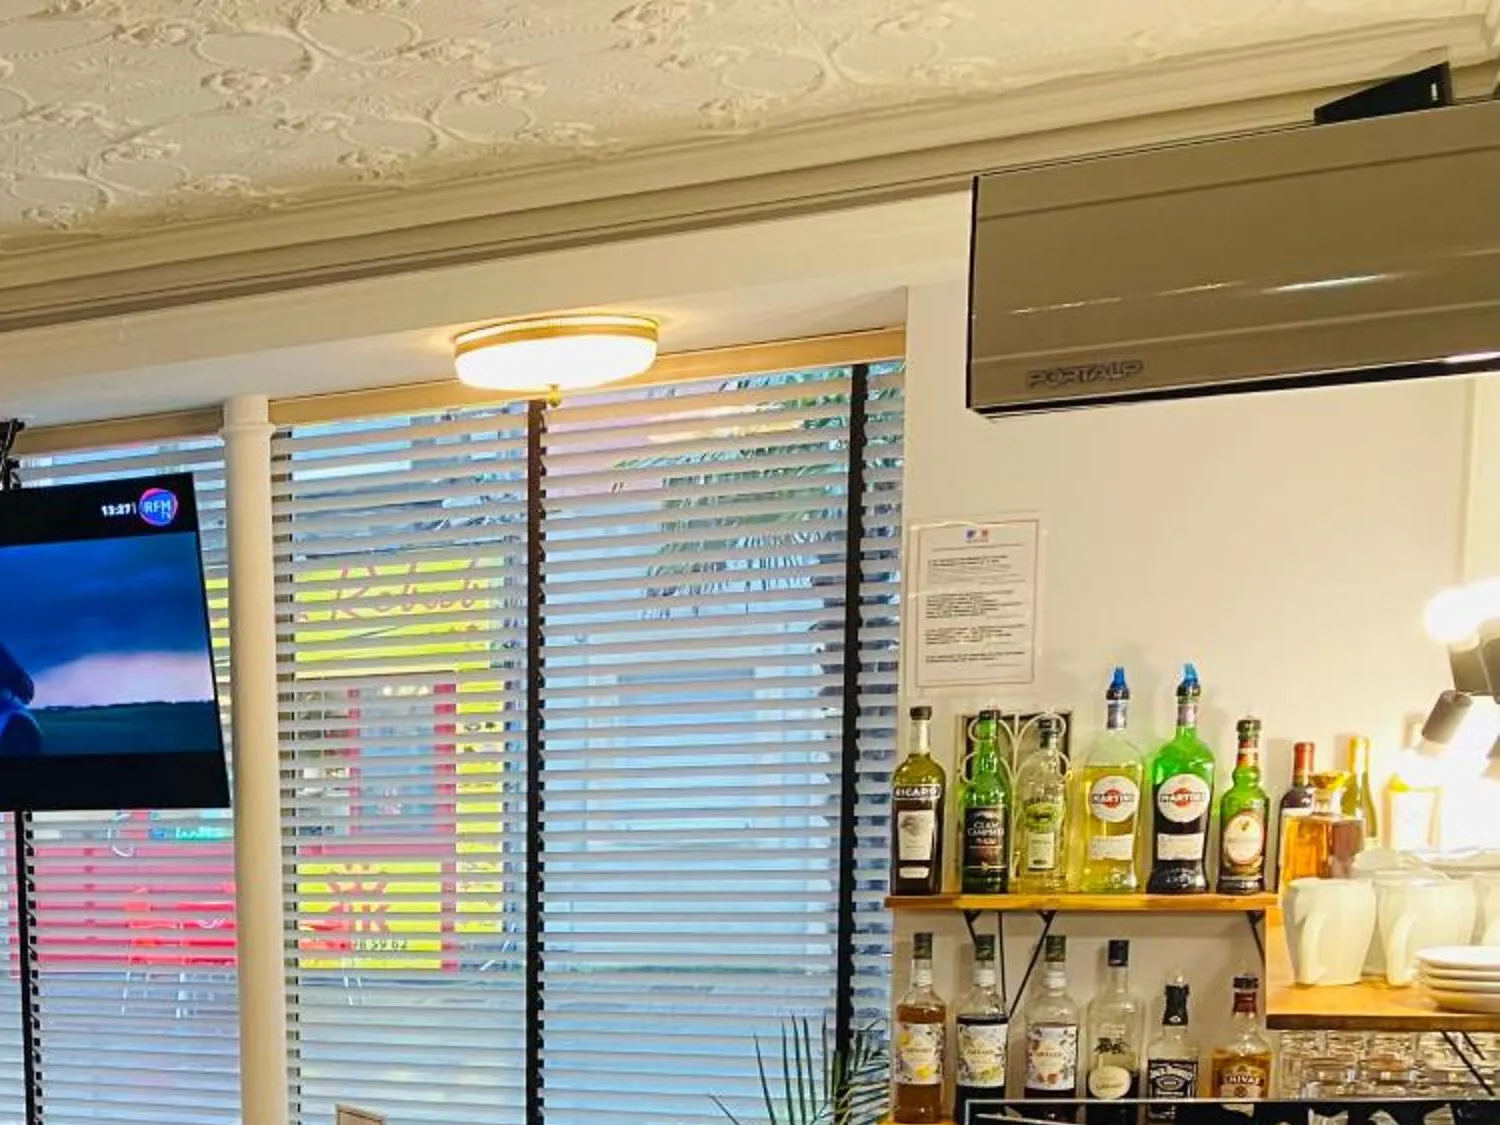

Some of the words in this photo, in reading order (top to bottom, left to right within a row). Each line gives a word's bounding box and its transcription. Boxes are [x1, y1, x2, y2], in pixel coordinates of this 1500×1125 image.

[1027, 359, 1143, 388] PORTALP
[101, 503, 131, 516] 13:27
[144, 500, 171, 513] RFM
